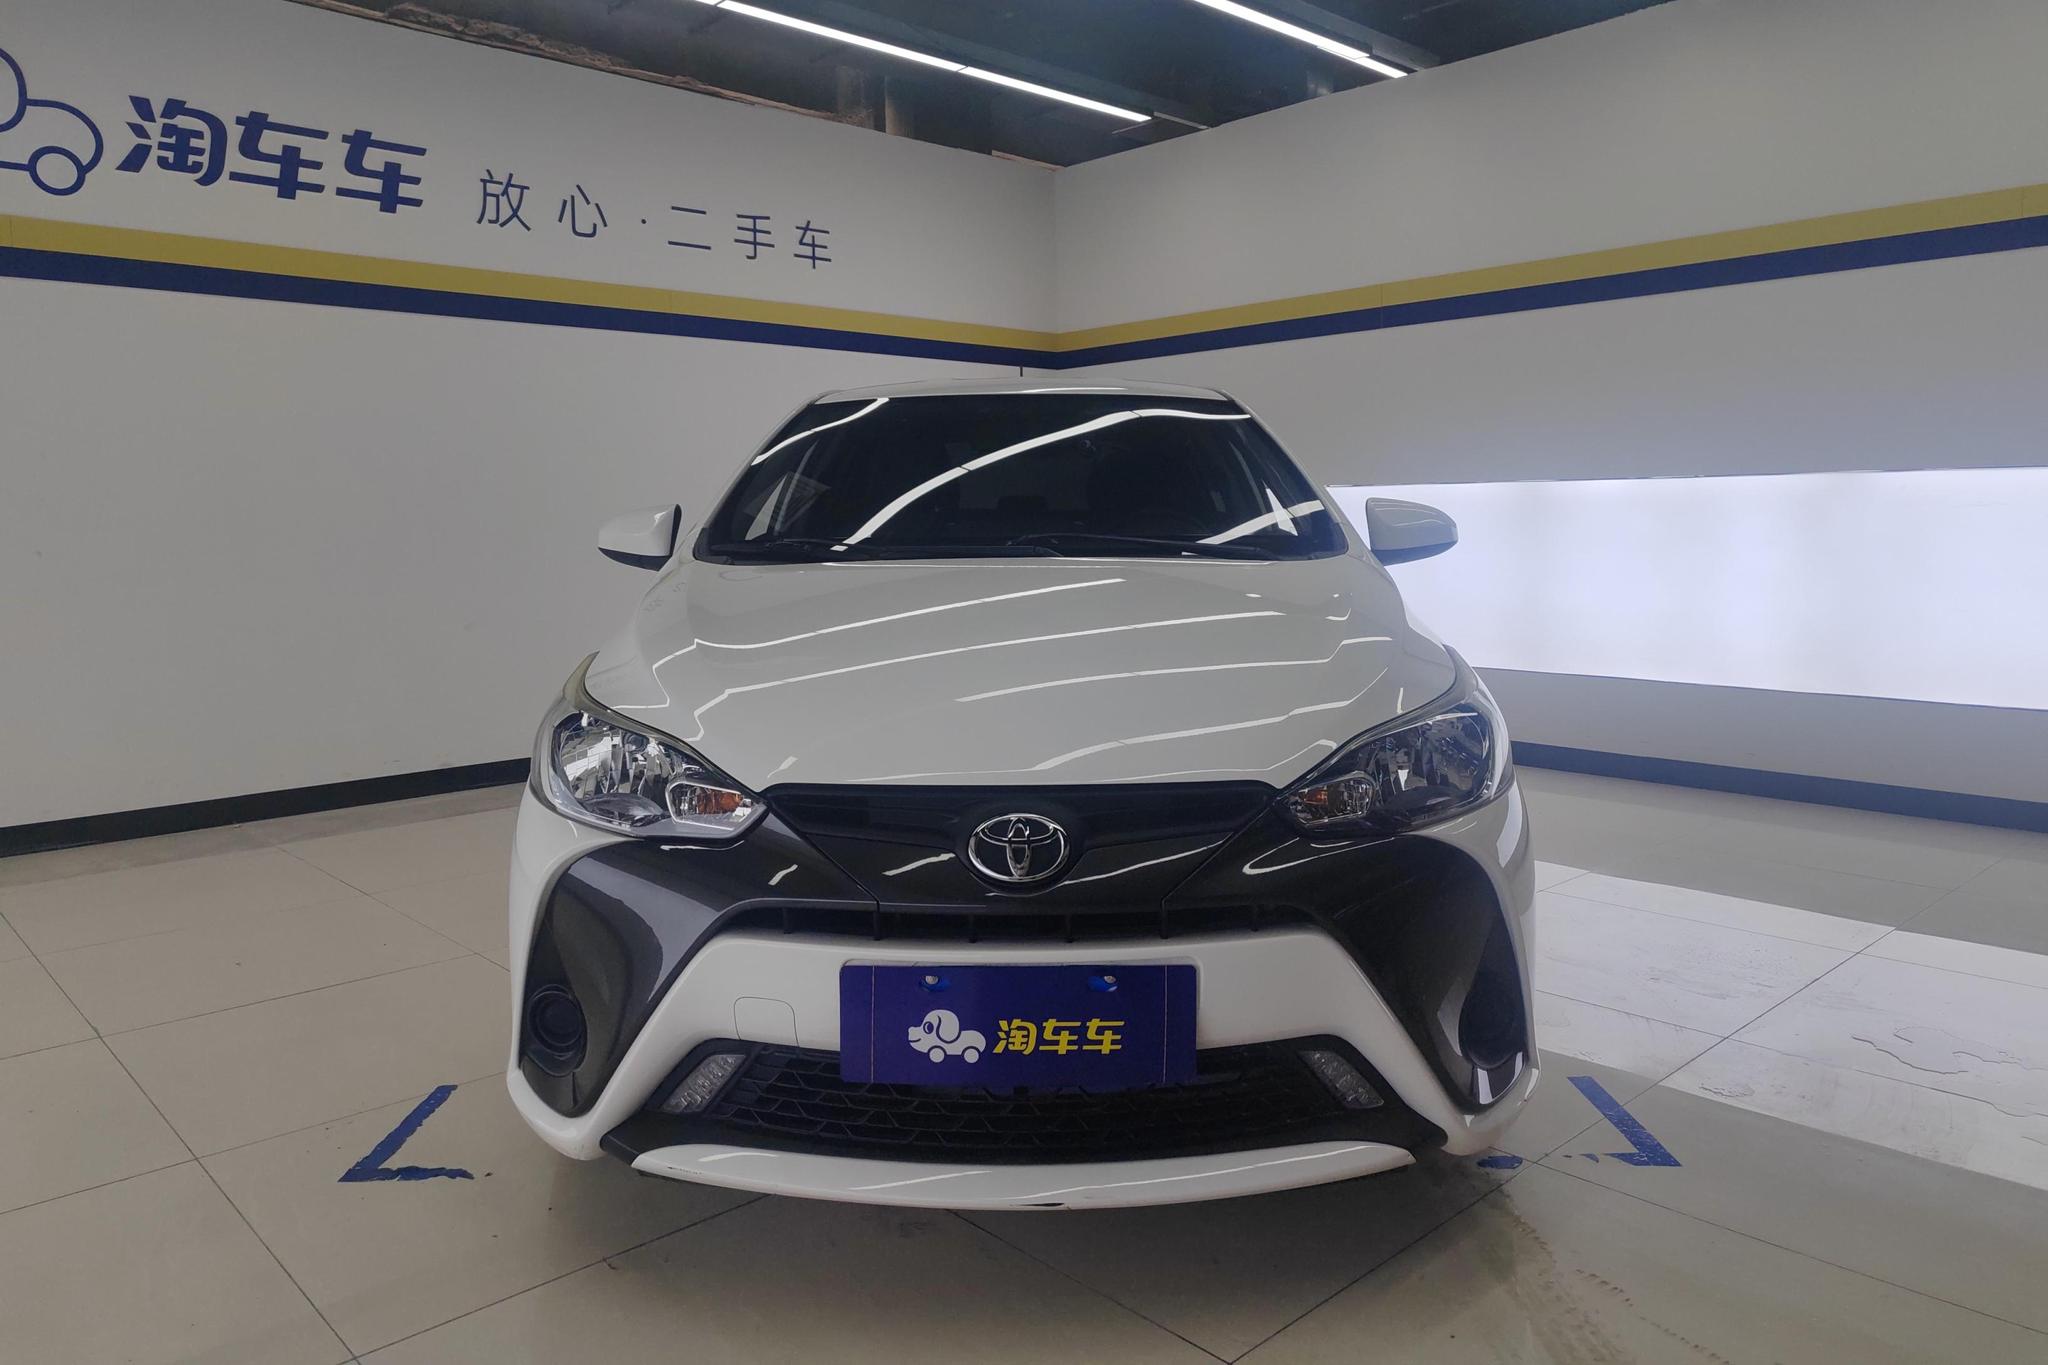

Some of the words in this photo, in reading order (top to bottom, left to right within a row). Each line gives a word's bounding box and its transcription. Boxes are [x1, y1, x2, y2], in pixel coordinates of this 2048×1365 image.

[115, 95, 427, 214] 淘车车
[993, 1018, 1124, 1055] 淘车车
